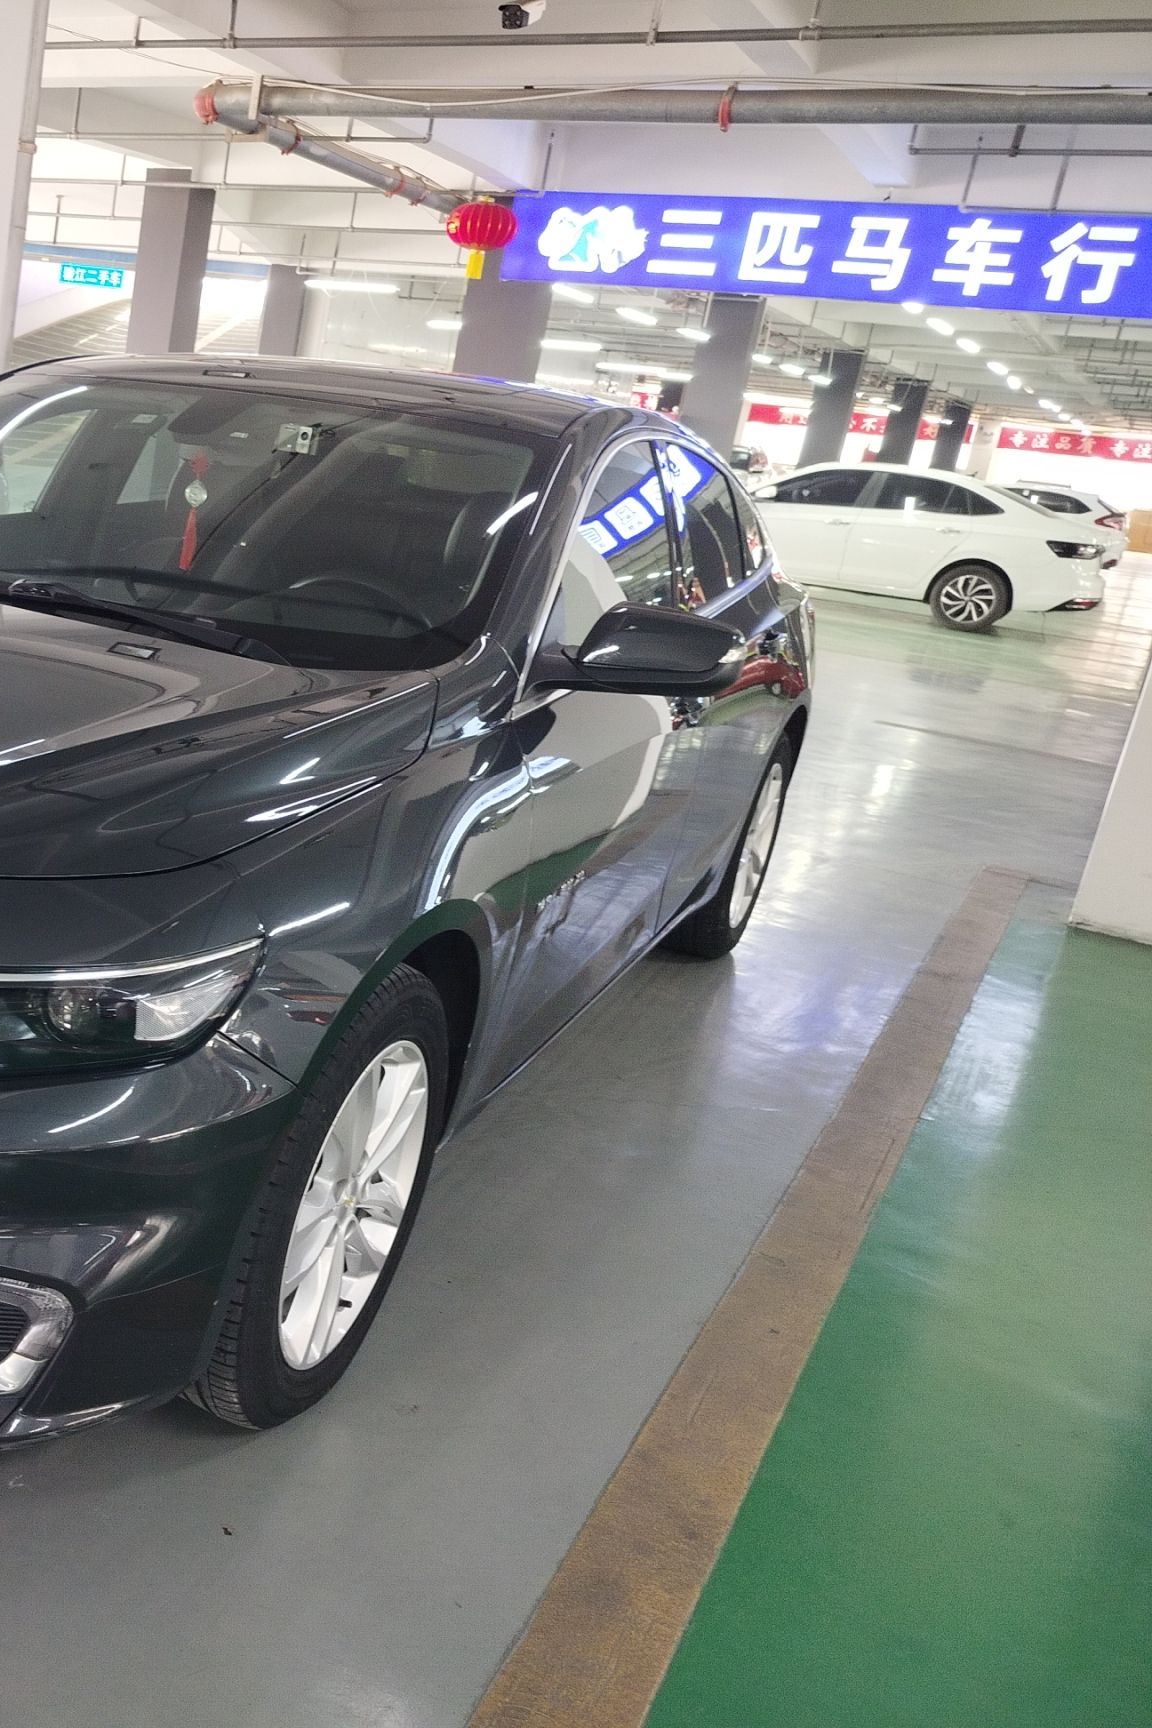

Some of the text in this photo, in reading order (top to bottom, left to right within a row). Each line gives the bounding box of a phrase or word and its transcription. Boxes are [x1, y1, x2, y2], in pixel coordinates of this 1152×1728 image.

[646, 208, 1139, 305] 三匹马车行
